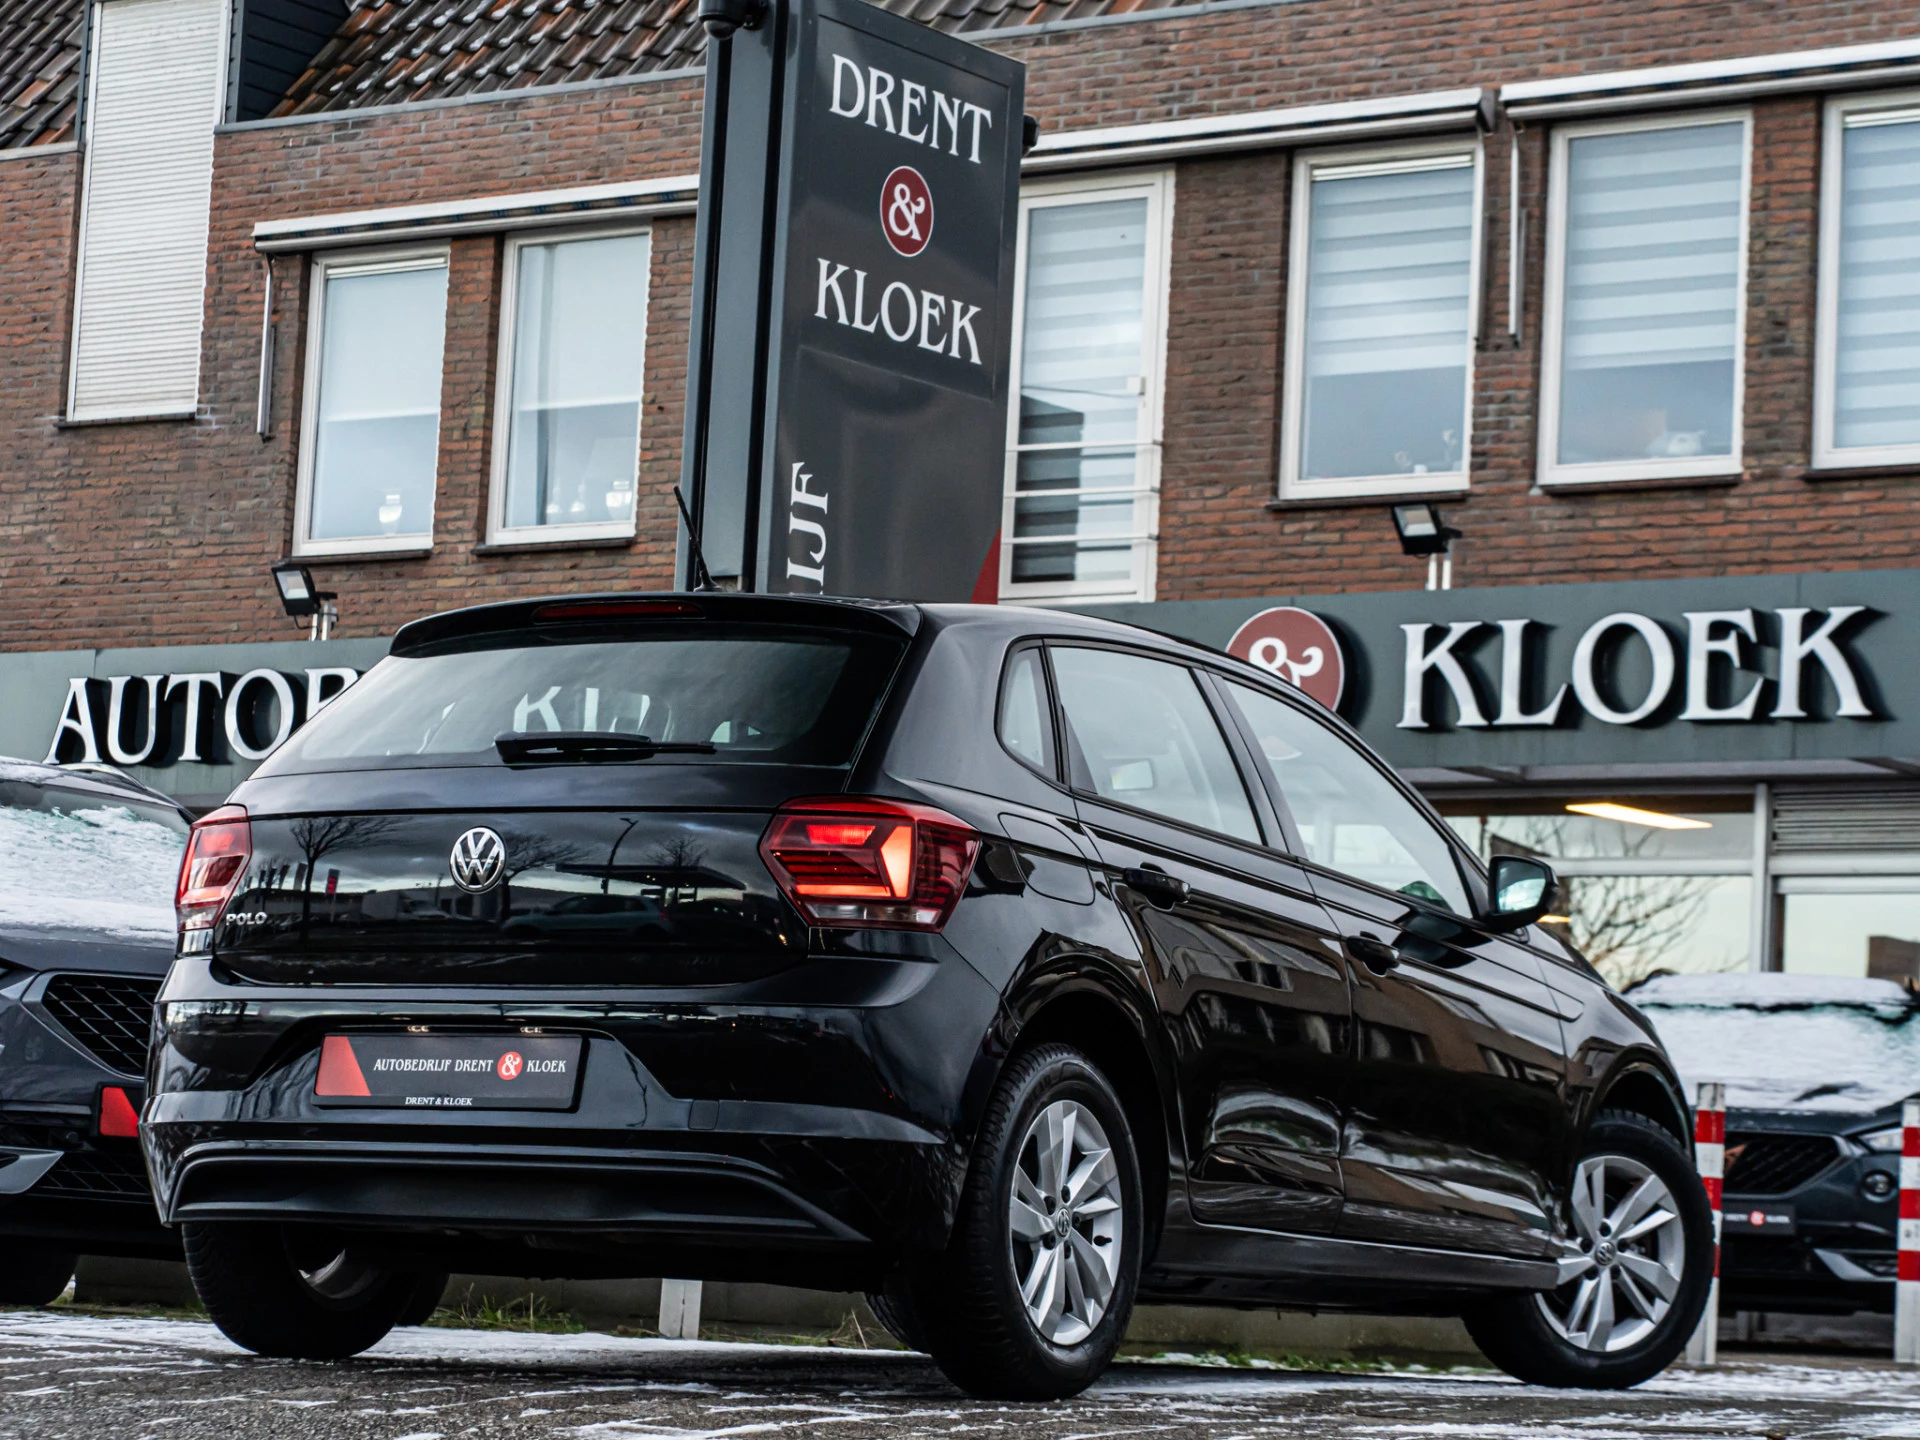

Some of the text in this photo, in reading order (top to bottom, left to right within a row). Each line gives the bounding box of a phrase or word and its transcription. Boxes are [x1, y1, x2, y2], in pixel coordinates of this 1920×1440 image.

[828, 53, 992, 165] DRENT
[888, 182, 926, 242] &
[814, 257, 982, 365] KLOEK
[1395, 605, 1873, 729] KLOEK
[226, 911, 268, 926] POLO
[373, 1054, 567, 1077] AUTOBEDRIJF DRENT & KLOEK
[405, 1096, 435, 1105] DRENT
[443, 1097, 473, 1106] KLOEK
